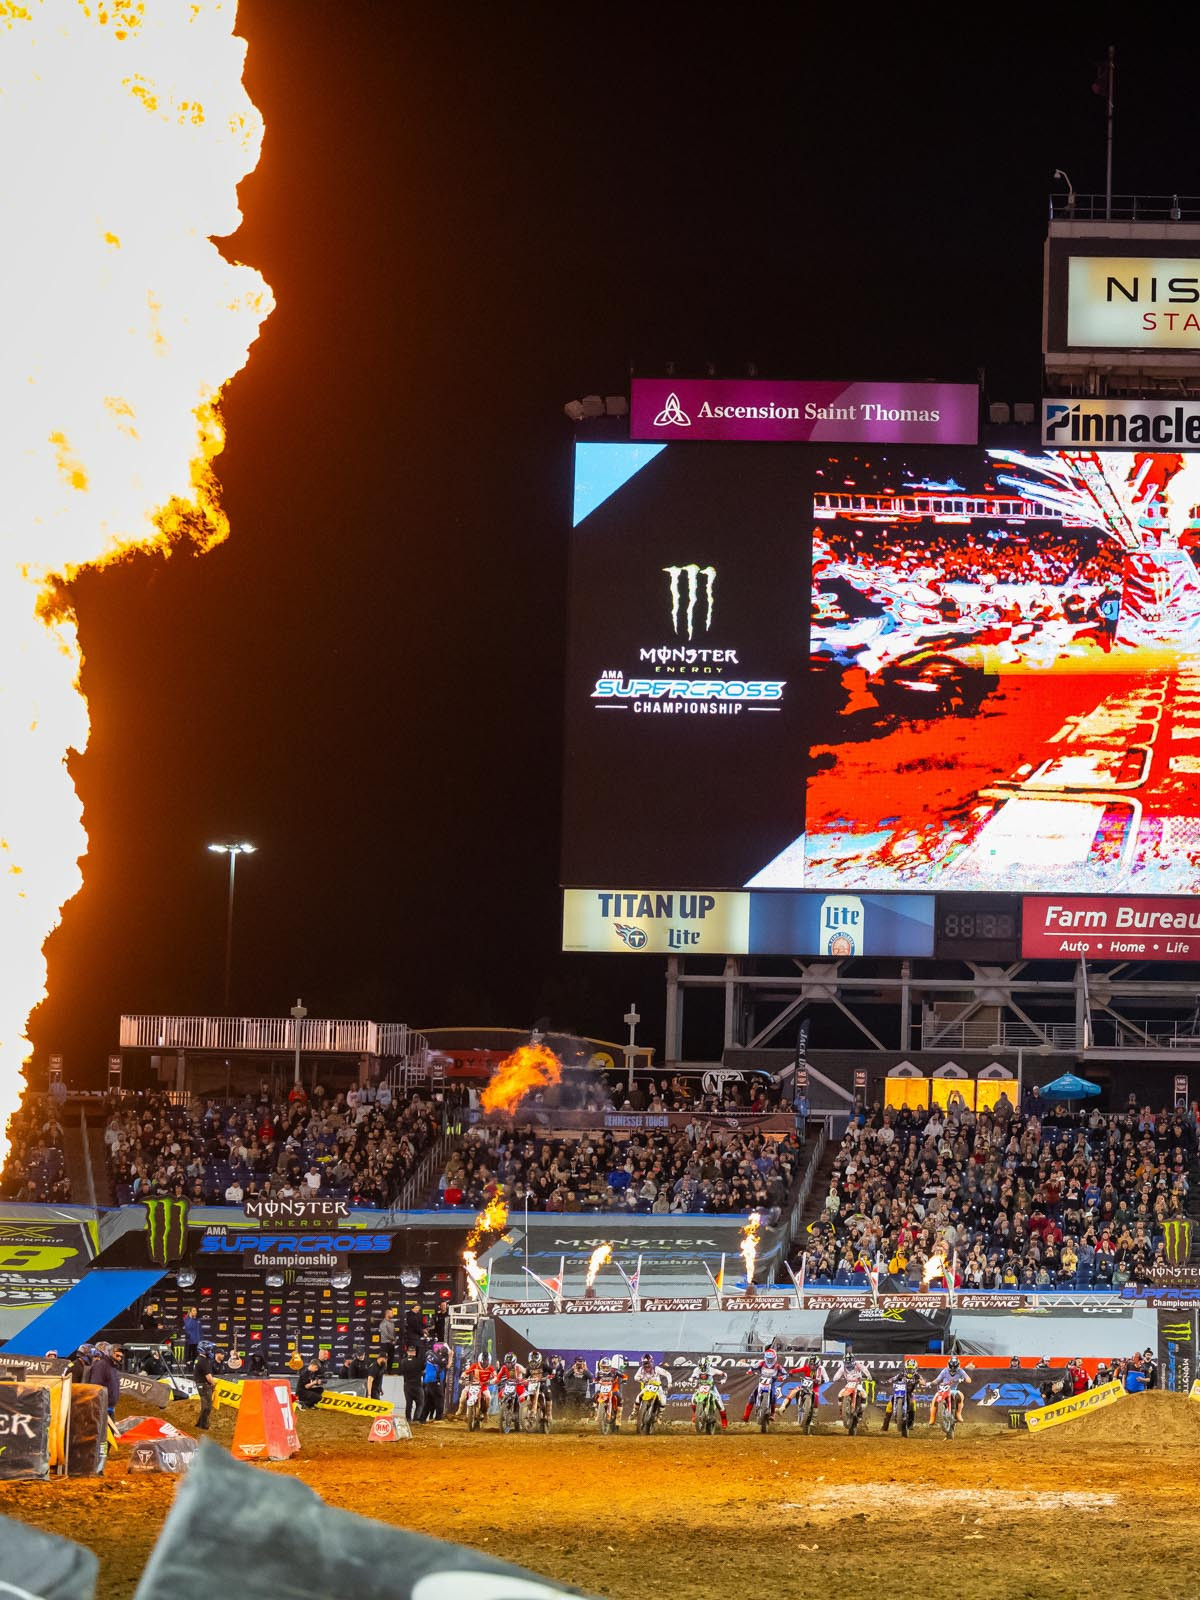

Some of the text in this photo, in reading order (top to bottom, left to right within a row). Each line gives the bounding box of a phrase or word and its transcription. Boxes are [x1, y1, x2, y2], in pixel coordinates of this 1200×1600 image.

[697, 401, 940, 422] Ascension Saint Thomas
[640, 646, 739, 664] MONSTER
[602, 670, 624, 679] AMA
[591, 679, 787, 700] SUPERCROSS
[634, 702, 742, 714] CHAMPIONSHIP
[598, 894, 715, 919] TITAN UP
[825, 906, 859, 930] Lite
[1044, 906, 1106, 927] Farm
[667, 928, 700, 948] Lite
[1059, 941, 1090, 953] Auto
[1110, 941, 1146, 953] Home
[1166, 942, 1189, 954] Life
[246, 1200, 349, 1217] MONSTER
[206, 1227, 226, 1236] AMA
[200, 1235, 392, 1252] SUPERCROSS
[254, 1254, 338, 1267] Championship
[321, 1397, 388, 1414] DUNLOP
[1044, 1389, 1111, 1422] DUNLOP
